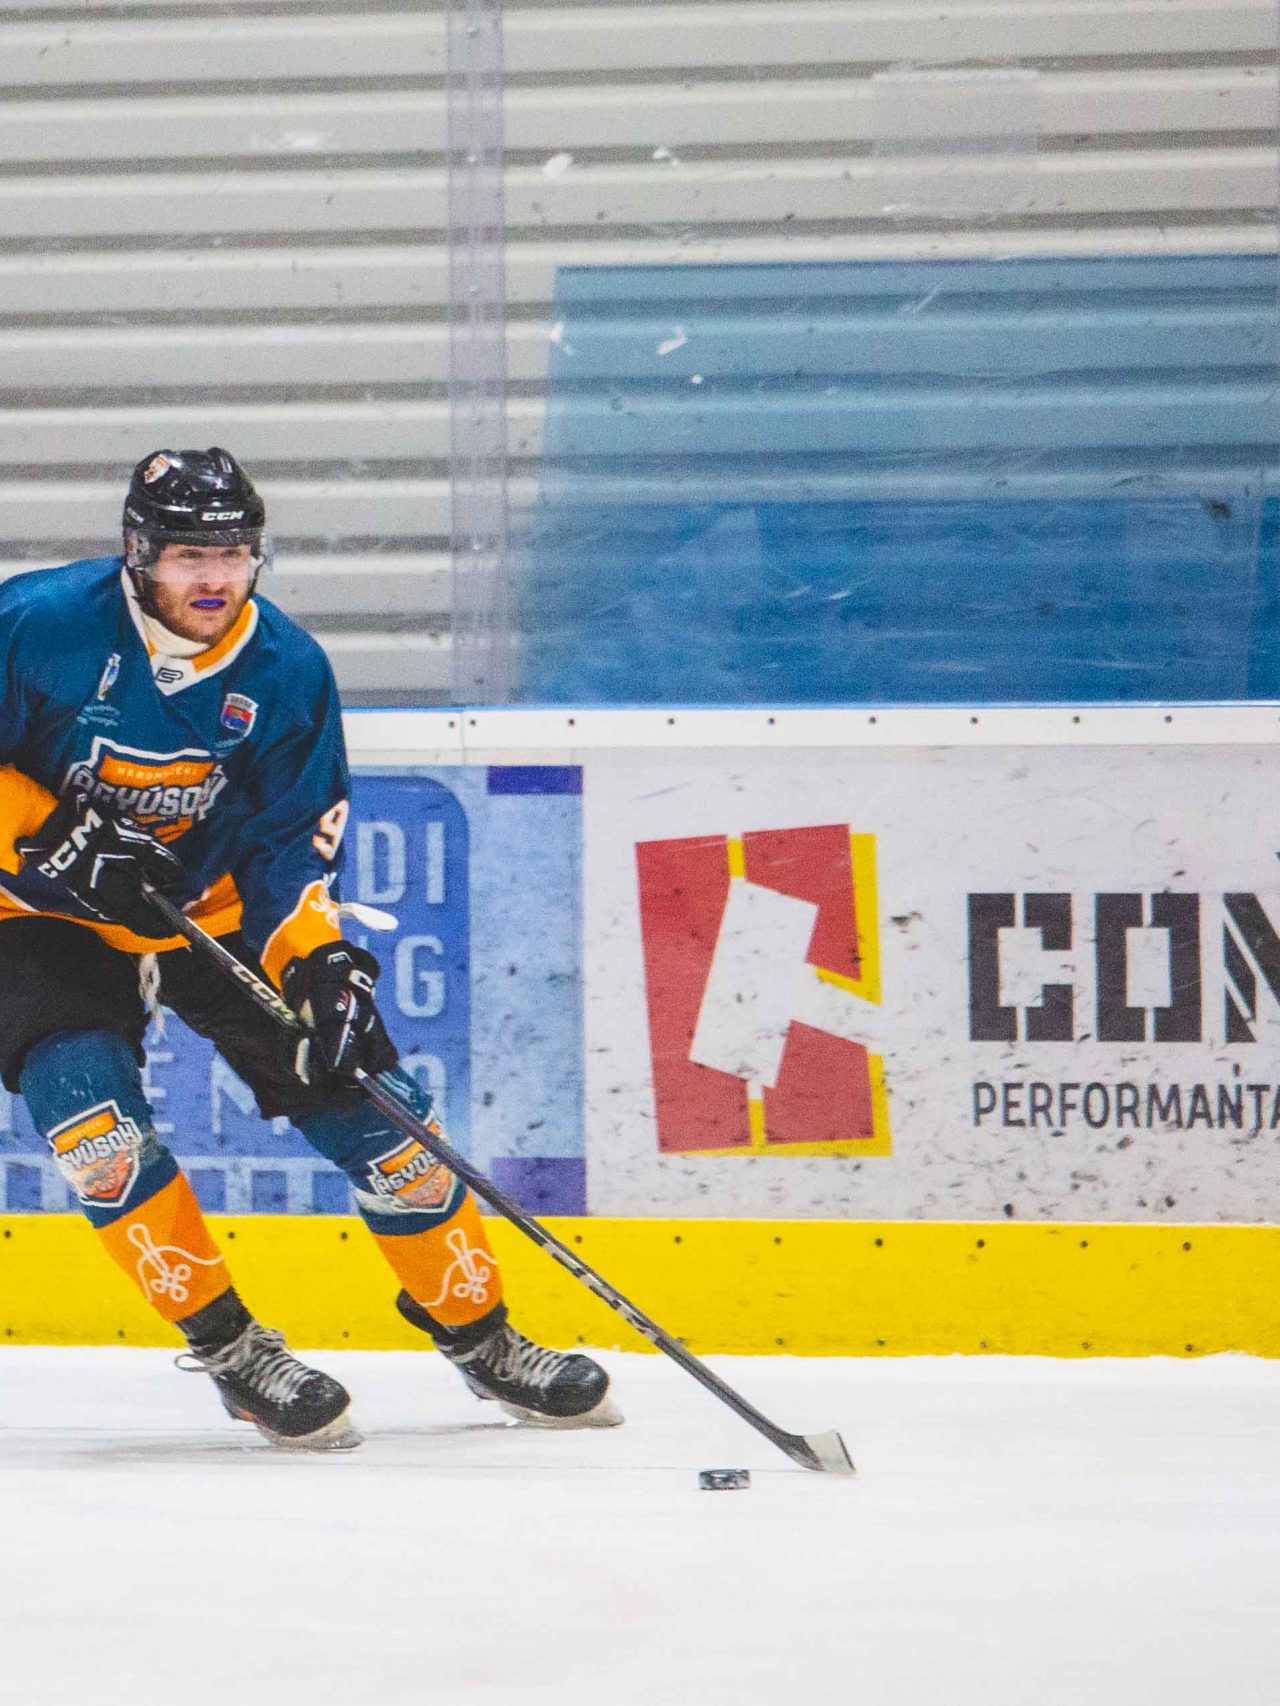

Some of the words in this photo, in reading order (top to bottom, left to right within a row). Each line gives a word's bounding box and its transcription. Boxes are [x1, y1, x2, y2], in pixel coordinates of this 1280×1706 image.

[201, 511, 245, 522] CCM
[37, 808, 104, 879] CCM
[312, 800, 350, 861] 9
